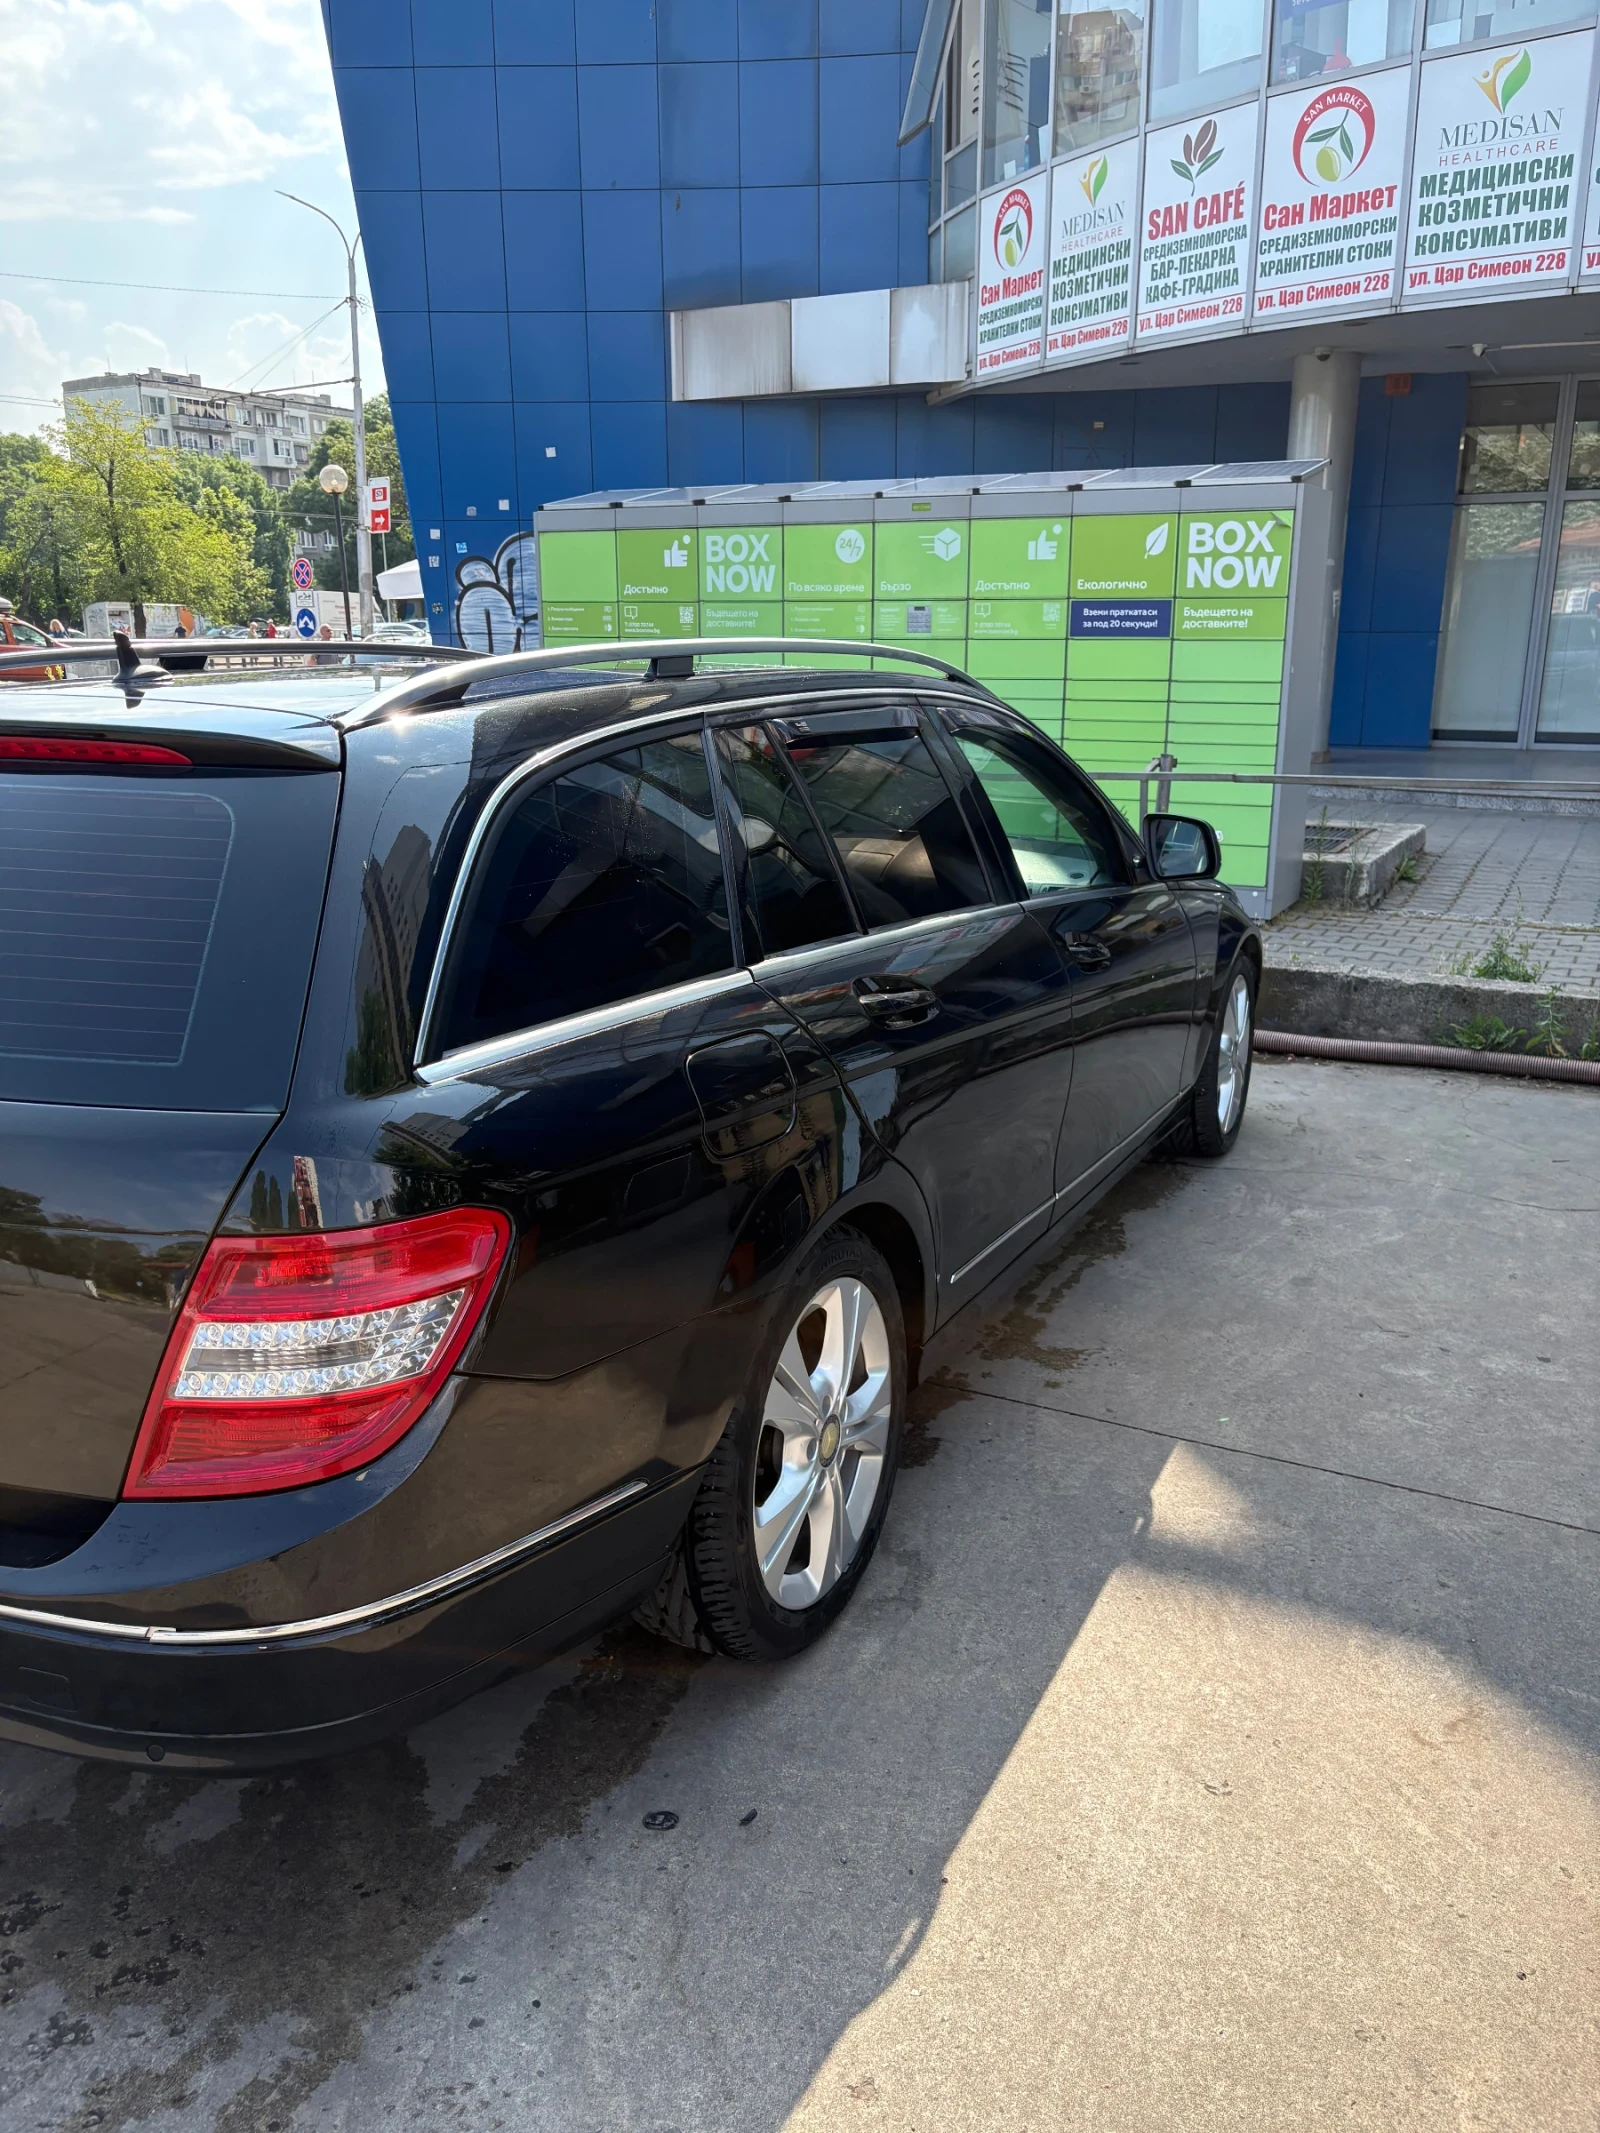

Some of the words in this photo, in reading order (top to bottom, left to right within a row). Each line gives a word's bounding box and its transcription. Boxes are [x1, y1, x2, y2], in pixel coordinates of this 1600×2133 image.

[1304, 101, 1324, 124] SAN
[1327, 92, 1368, 112] MARKET
[1439, 108, 1564, 150] MEDISAN
[1439, 139, 1559, 167] HEALTHCARE
[1419, 154, 1575, 198] МЕДИЦИНСКИ
[1062, 201, 1125, 239] MEDISAN
[1148, 202, 1189, 241] SAN
[1194, 181, 1245, 230] CAFÉ
[1264, 203, 1305, 230] Сан
[1309, 185, 1398, 222] Маркет
[1418, 185, 1570, 227] КОЗМЕТИЧНИ
[1062, 226, 1123, 252] HEALTHCARE
[1144, 224, 1248, 262] СРЕДИЗЕМНОМОРСКА
[1259, 216, 1398, 255] СРЕДИЗЕМНОМОРСКИ
[1414, 217, 1568, 257] КОНСУМАТИВИ
[1052, 239, 1131, 279] МЕДИЦИНСКИ
[1151, 246, 1236, 282] БАР-ПЕКАРНА
[1259, 248, 1344, 278] ХРАНИТЕЛНИ
[1347, 240, 1393, 263] СТОКИ
[1409, 272, 1431, 288] ул.
[1435, 266, 1464, 285] Цар
[1468, 259, 1532, 280] Симеон
[1535, 252, 1566, 272] 228
[981, 284, 1000, 307] Сан
[1002, 269, 1044, 300] Маркет
[1052, 264, 1129, 302] КОЗМЕТИЧНИ
[1146, 268, 1239, 304] КАФЕ-ГРАДИНА
[1258, 295, 1276, 311] ул.
[1279, 290, 1304, 308] Цар
[1307, 281, 1361, 302] Симеон
[1364, 274, 1390, 292] 228
[1050, 290, 1128, 326] КОНСУМАТИВИ
[1140, 318, 1153, 332] ул.
[1155, 312, 1175, 330] Цар
[1178, 304, 1220, 323] Симеон
[1222, 297, 1242, 315] 228
[1048, 339, 1059, 352] ул.
[1061, 334, 1076, 349] Цар
[1078, 325, 1110, 344] Симеон
[1112, 320, 1128, 337] 228
[706, 534, 770, 563] BOX
[840, 538, 862, 557] 24/7
[1188, 520, 1276, 554] BOX
[706, 564, 776, 593] NOW
[788, 582, 803, 592] По
[804, 584, 832, 592] всяко
[834, 584, 865, 594] време
[880, 581, 911, 593] Бързо
[975, 580, 1030, 592] Достъпно
[1078, 579, 1147, 590] Екологично
[1187, 556, 1282, 589] NOW
[624, 585, 669, 596] Достъпно
[706, 609, 747, 618] Бъдещето
[706, 619, 756, 628] доставките!
[1083, 608, 1108, 616] Вземи
[1110, 609, 1147, 618] пратката
[1093, 621, 1109, 629] под
[1110, 620, 1120, 628] 20
[1121, 620, 1158, 630] секунди!
[1183, 619, 1249, 630] доставките!
[1184, 607, 1239, 618] Бъдещето
[1240, 608, 1253, 617] на
